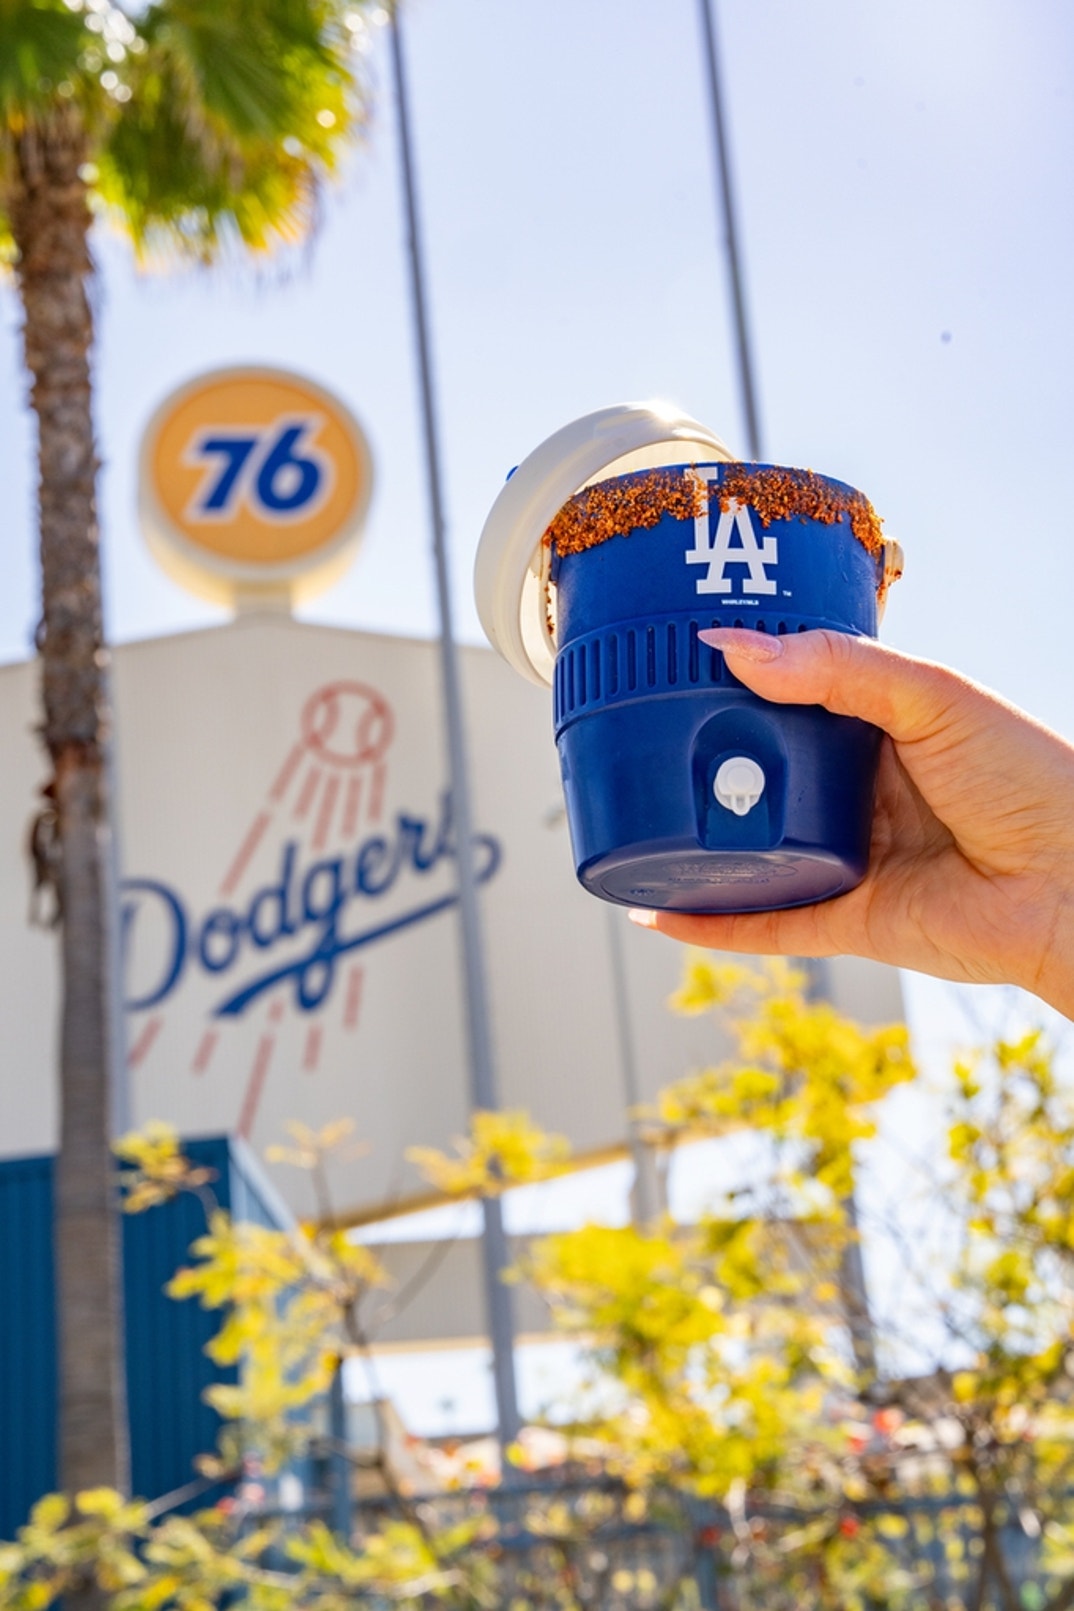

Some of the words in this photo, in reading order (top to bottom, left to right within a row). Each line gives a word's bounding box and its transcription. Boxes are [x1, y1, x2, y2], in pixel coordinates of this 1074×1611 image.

[196, 420, 326, 516] 76
[684, 466, 779, 595] LA
[116, 787, 503, 1017] Dodgers
